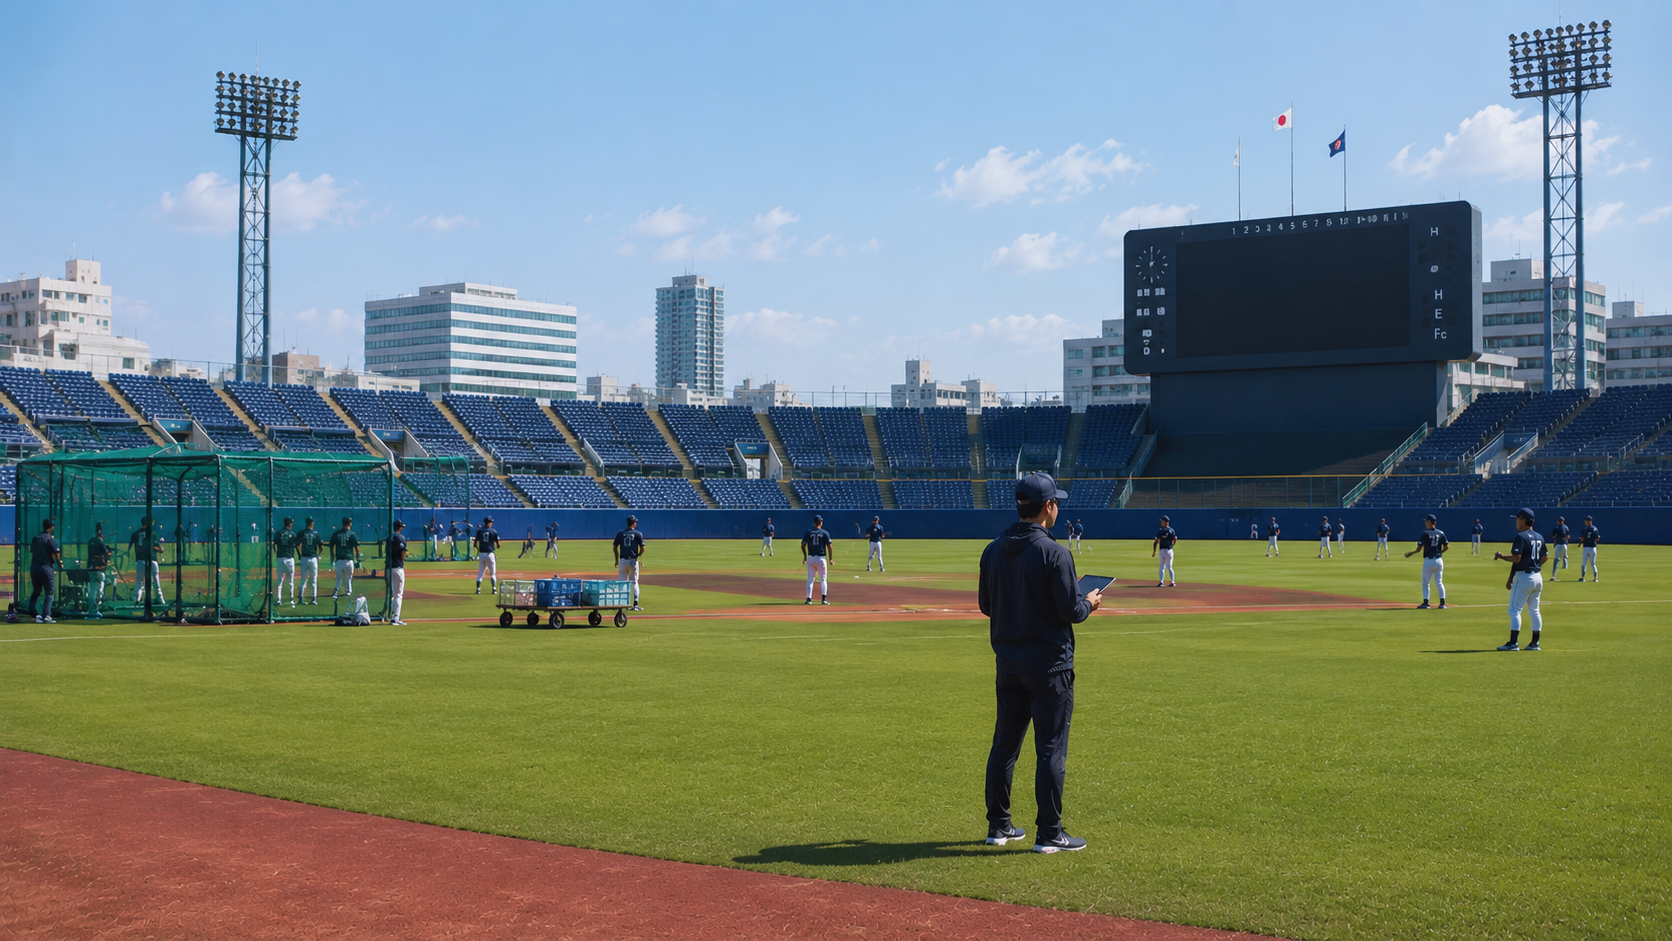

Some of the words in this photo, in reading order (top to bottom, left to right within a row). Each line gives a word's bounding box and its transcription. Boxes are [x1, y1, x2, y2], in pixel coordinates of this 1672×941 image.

[1243, 225, 1249, 234] 2
[1302, 220, 1308, 229] 6
[1313, 219, 1319, 227] 7
[1430, 226, 1439, 237] H
[1434, 289, 1443, 300] H
[1434, 308, 1443, 319] E
[1434, 327, 1447, 340] Fc
[1143, 346, 1151, 356] D
